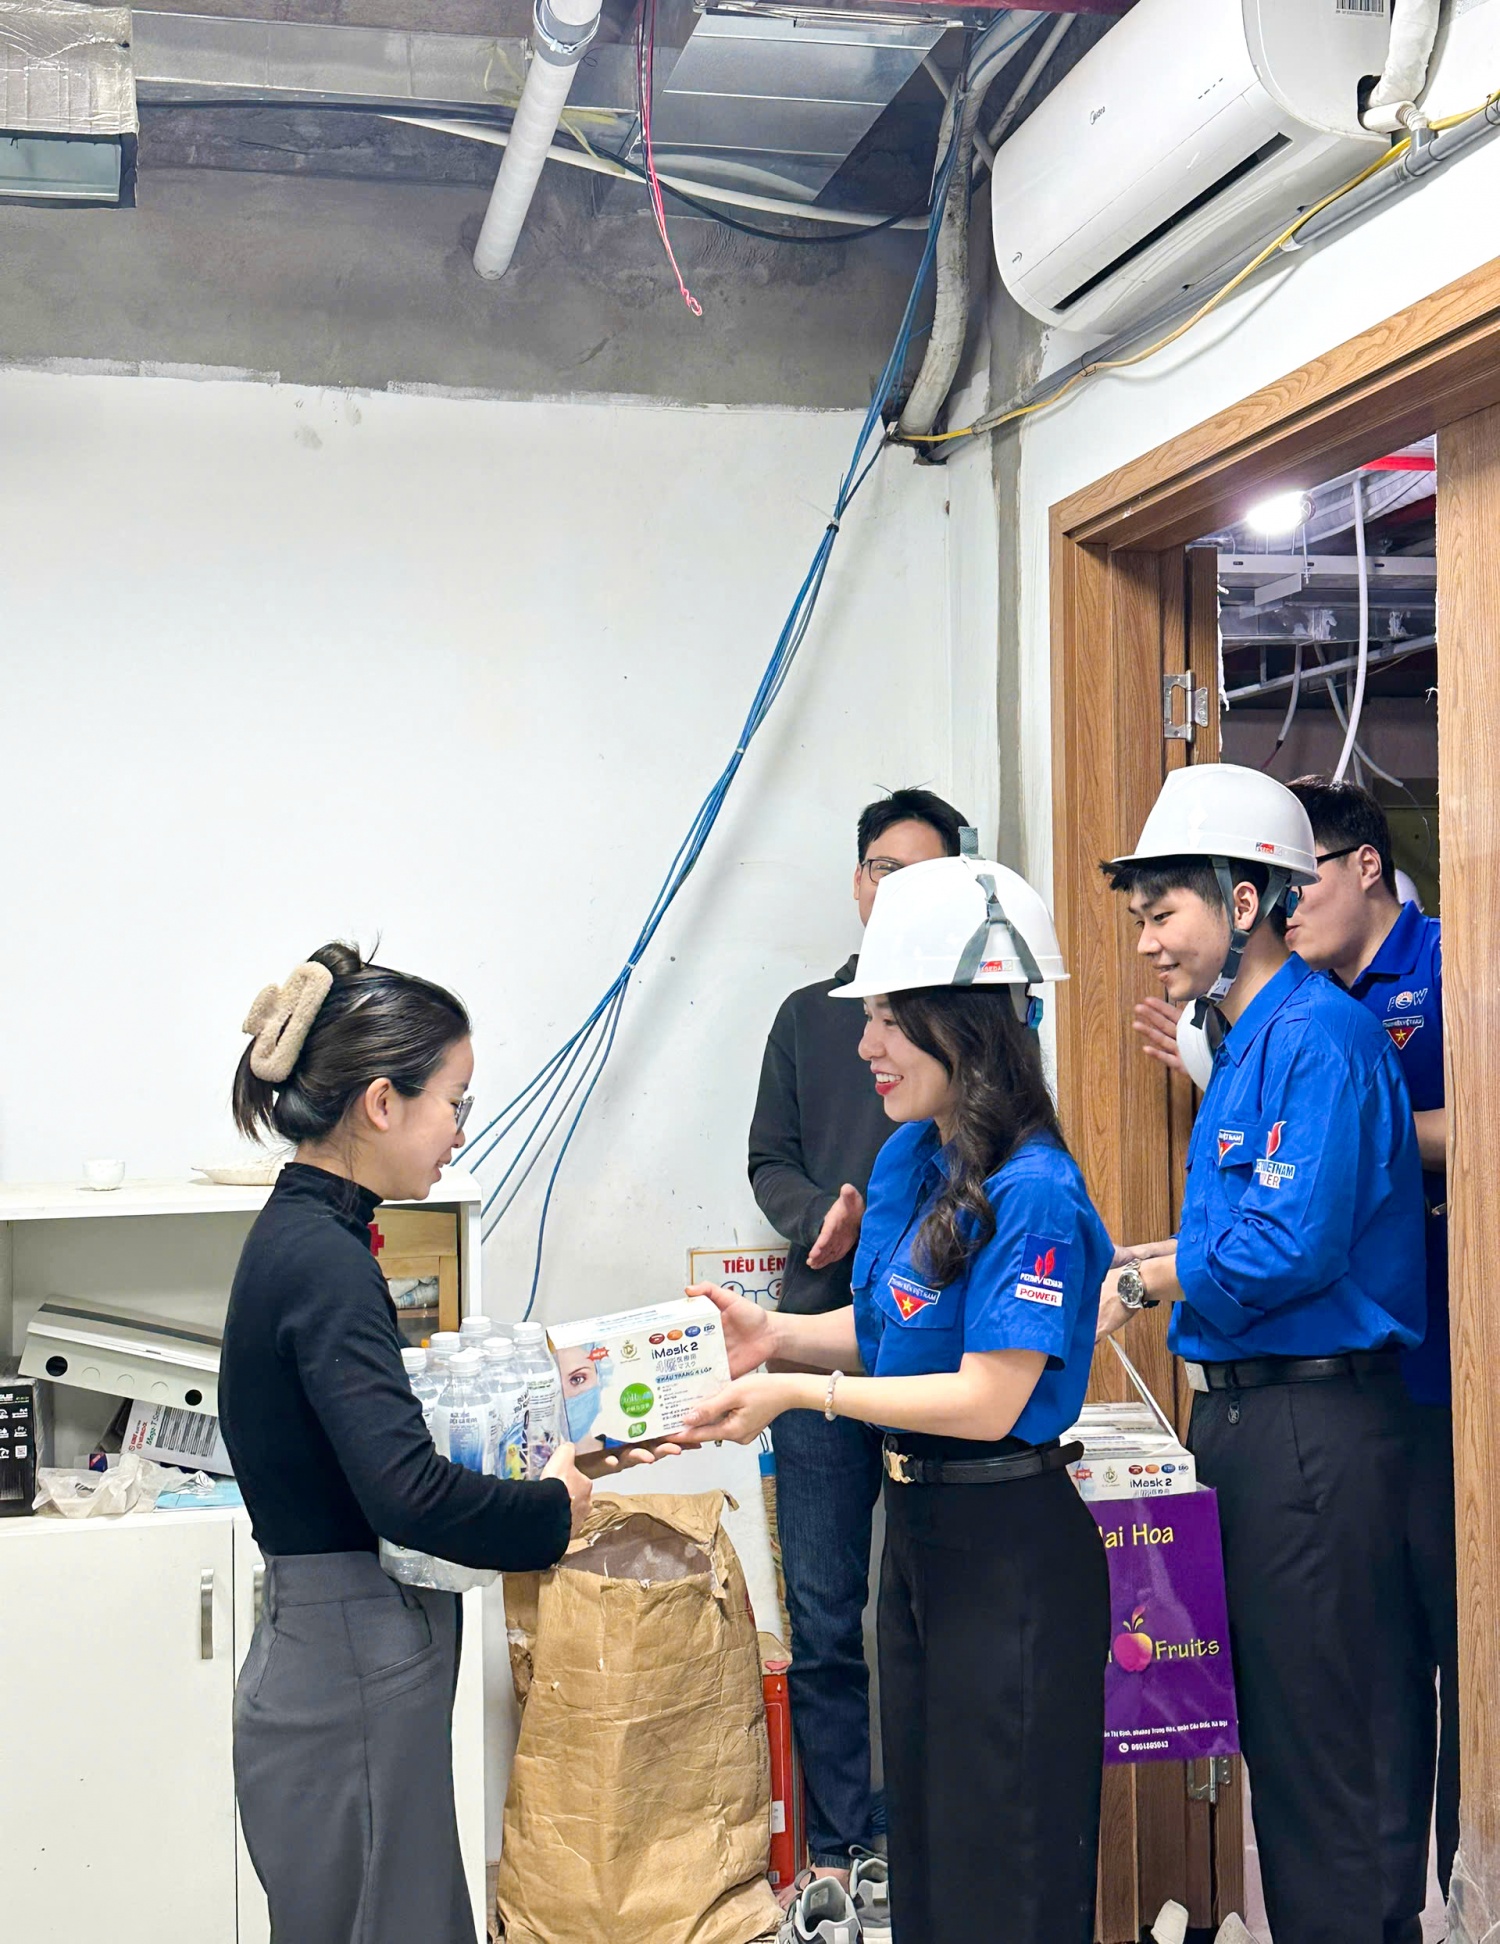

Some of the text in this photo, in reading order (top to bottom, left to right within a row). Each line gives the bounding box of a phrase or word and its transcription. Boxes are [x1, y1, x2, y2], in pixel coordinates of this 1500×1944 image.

[723, 1255, 786, 1274] TIÊU LỆN
[1020, 1288, 1057, 1303] POWER
[651, 1341, 699, 1359] iMask 2
[1130, 1478, 1163, 1488] iMask
[1165, 1478, 1172, 1486] 2
[1132, 1523, 1174, 1546] Hoa
[1155, 1638, 1220, 1660] Fruits
